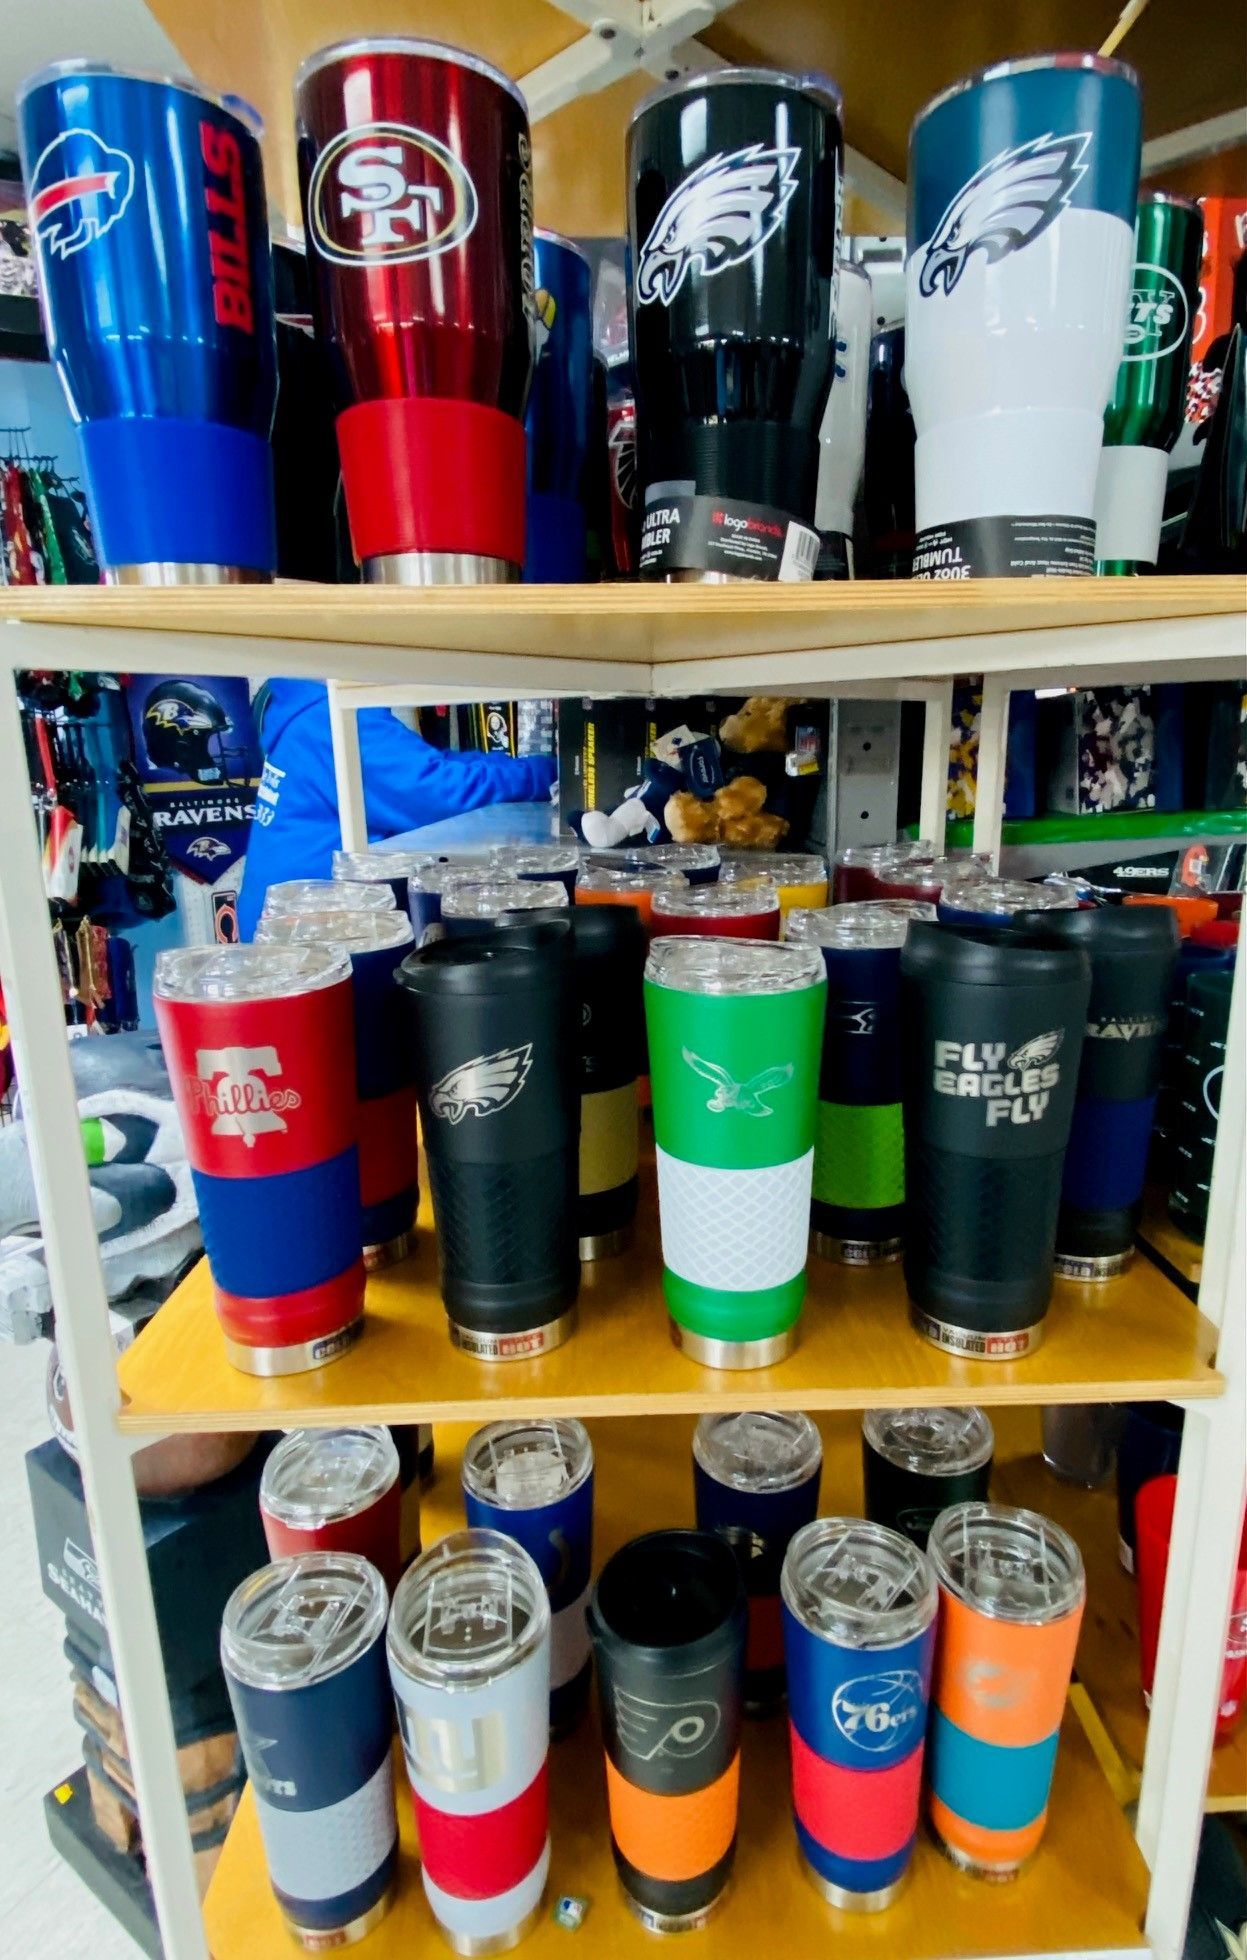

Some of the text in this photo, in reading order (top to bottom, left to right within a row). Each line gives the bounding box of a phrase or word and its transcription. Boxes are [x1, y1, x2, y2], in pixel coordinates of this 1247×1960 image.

[200, 121, 254, 335] BILLS
[646, 507, 681, 530] ULTRA
[152, 804, 258, 827] RAVENS
[169, 797, 240, 808] BALTIMORE
[1112, 865, 1170, 878] 49ERS
[934, 1040, 1007, 1071] FLY
[184, 1075, 302, 1117] Phillies
[933, 1063, 1060, 1097] EAGLES
[985, 1092, 1050, 1127] FLY
[840, 1699, 918, 1736] 76ers
